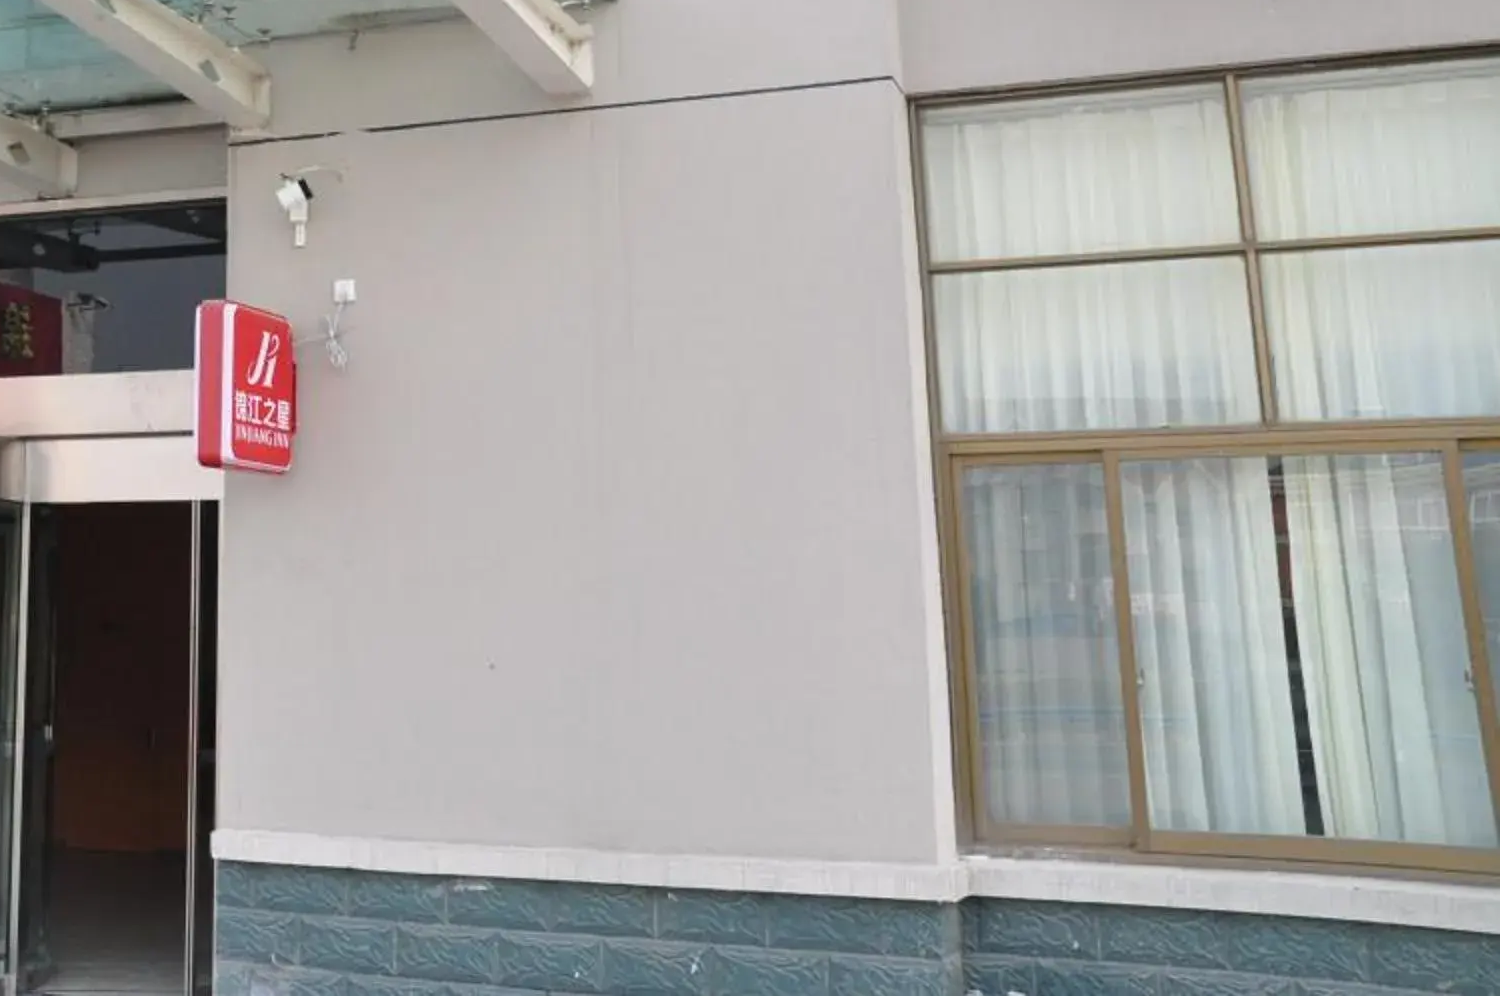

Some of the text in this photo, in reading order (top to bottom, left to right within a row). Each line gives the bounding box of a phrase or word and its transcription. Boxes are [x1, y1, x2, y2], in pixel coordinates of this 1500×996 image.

[235, 390, 291, 430] 锦江之星
[272, 431, 289, 450] INN
